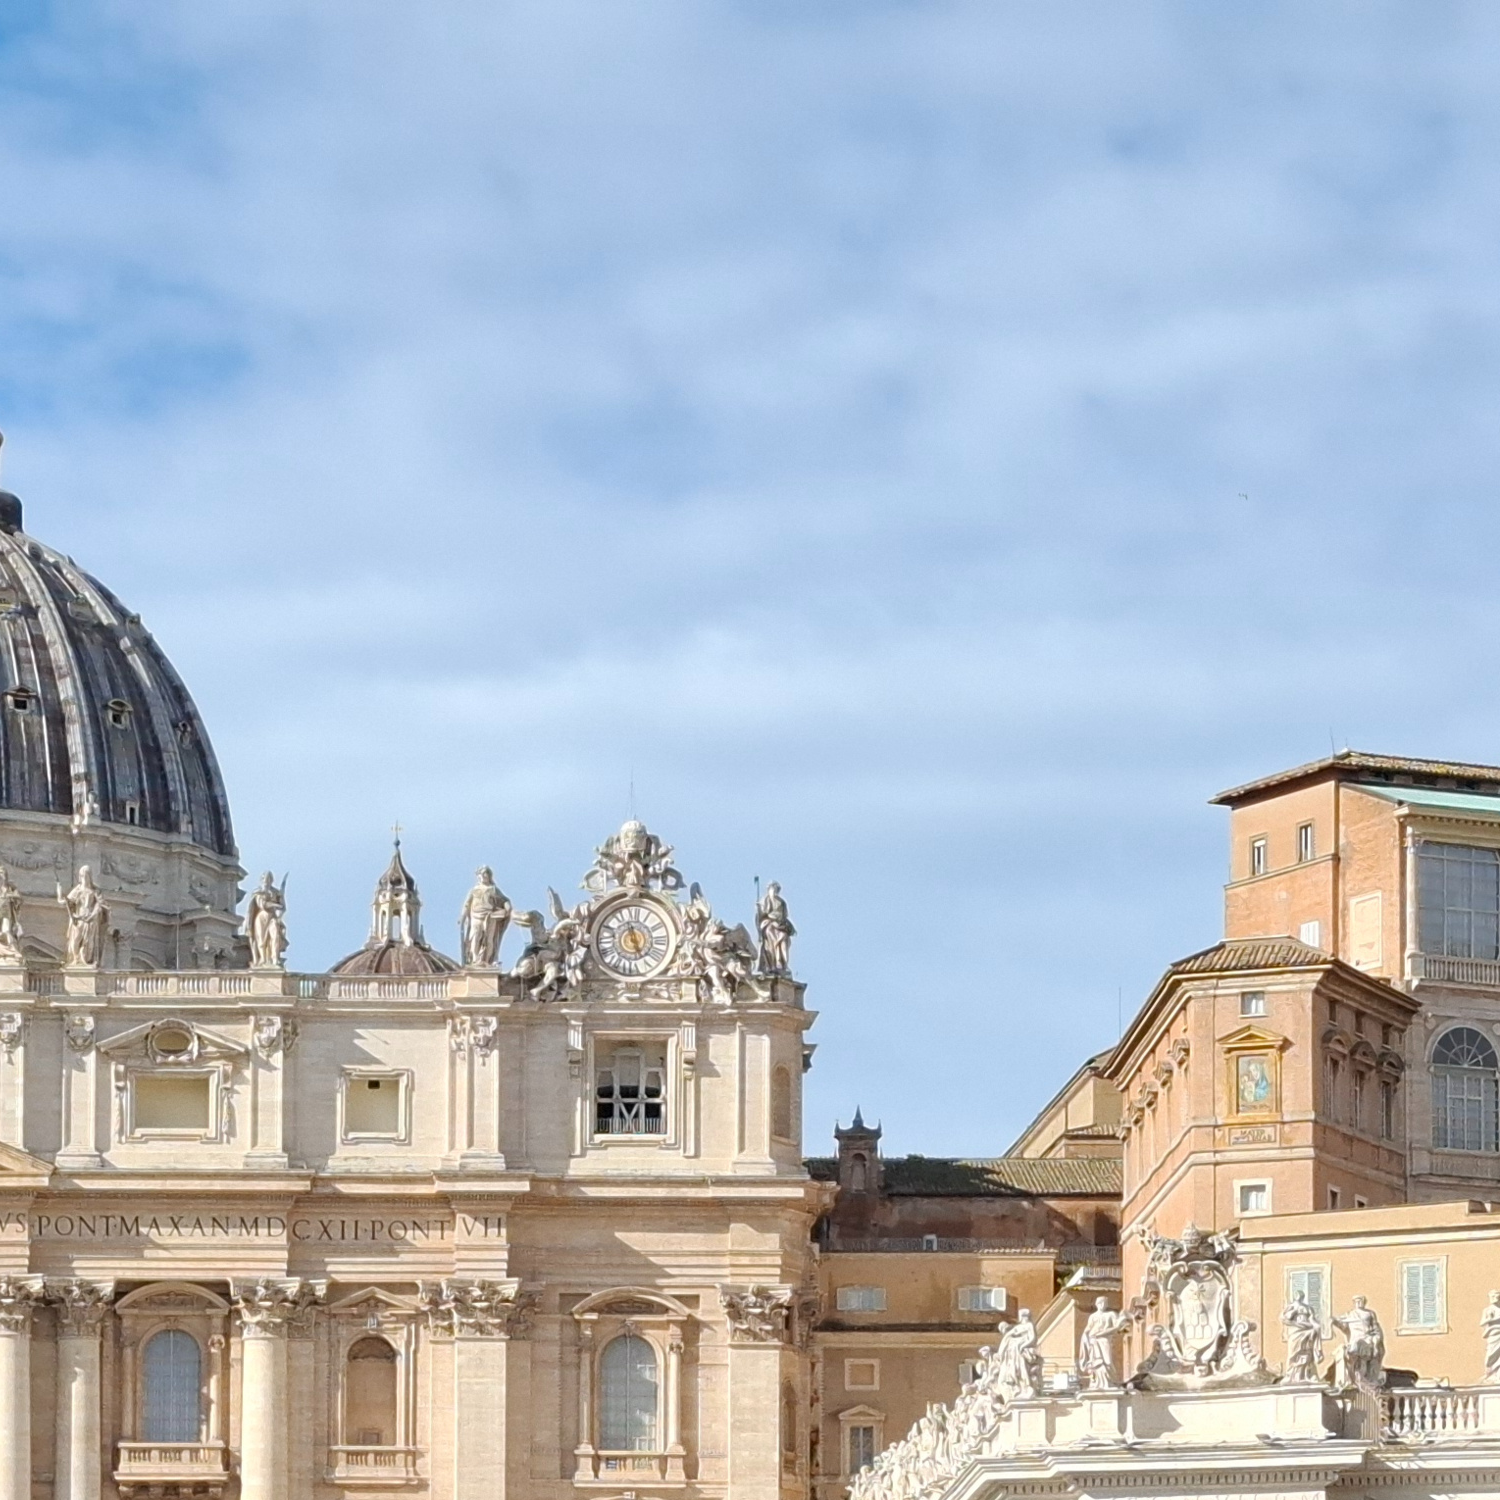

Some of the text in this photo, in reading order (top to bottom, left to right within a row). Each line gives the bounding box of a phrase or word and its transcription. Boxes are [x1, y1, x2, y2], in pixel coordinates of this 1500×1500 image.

[37, 1215, 116, 1237] PONT
[118, 1215, 186, 1237] MAX
[370, 1219, 451, 1241] PONT
[461, 1216, 505, 1238] VII
